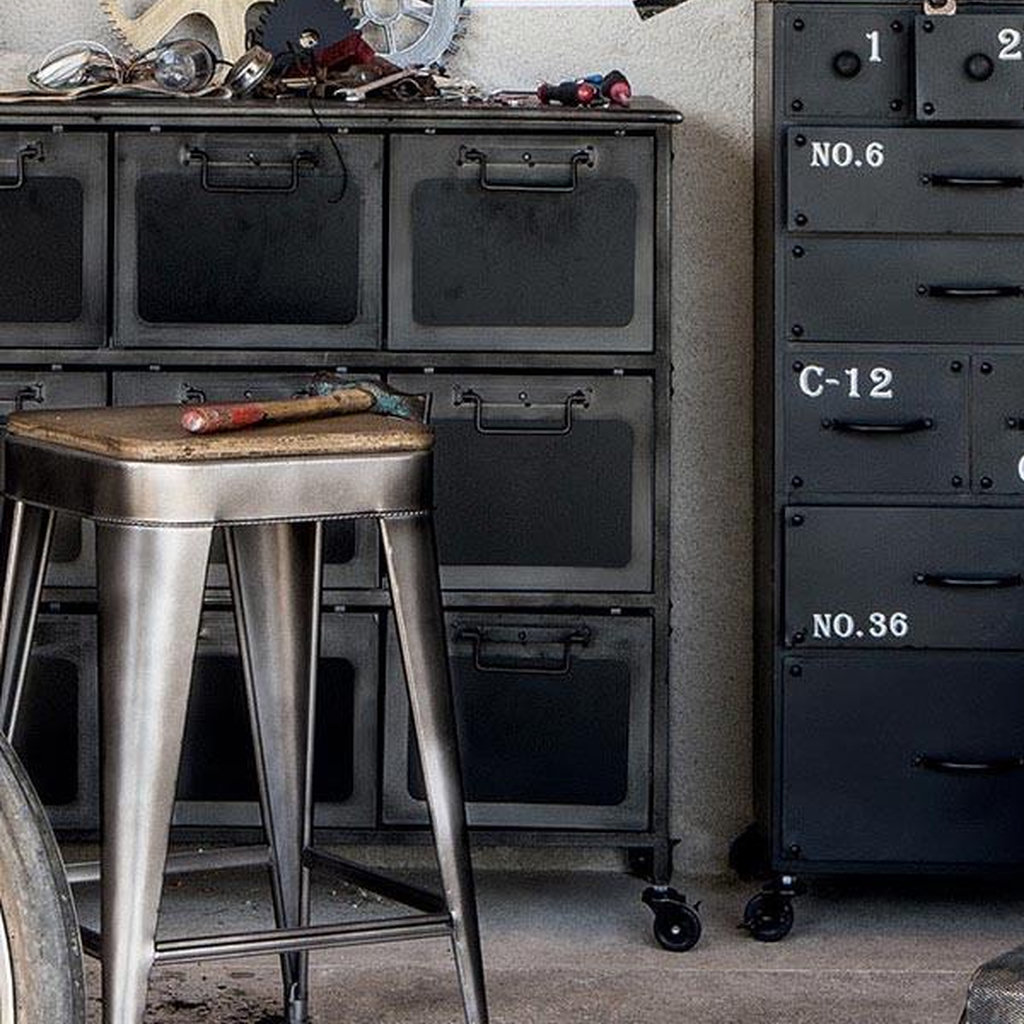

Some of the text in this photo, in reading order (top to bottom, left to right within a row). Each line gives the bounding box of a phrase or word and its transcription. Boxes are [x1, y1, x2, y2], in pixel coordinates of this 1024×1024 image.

[866, 31, 882, 62] 1
[998, 28, 1022, 60] 2
[809, 142, 885, 168] NO.6
[799, 366, 894, 399] C-12
[812, 611, 909, 639] NO.36
